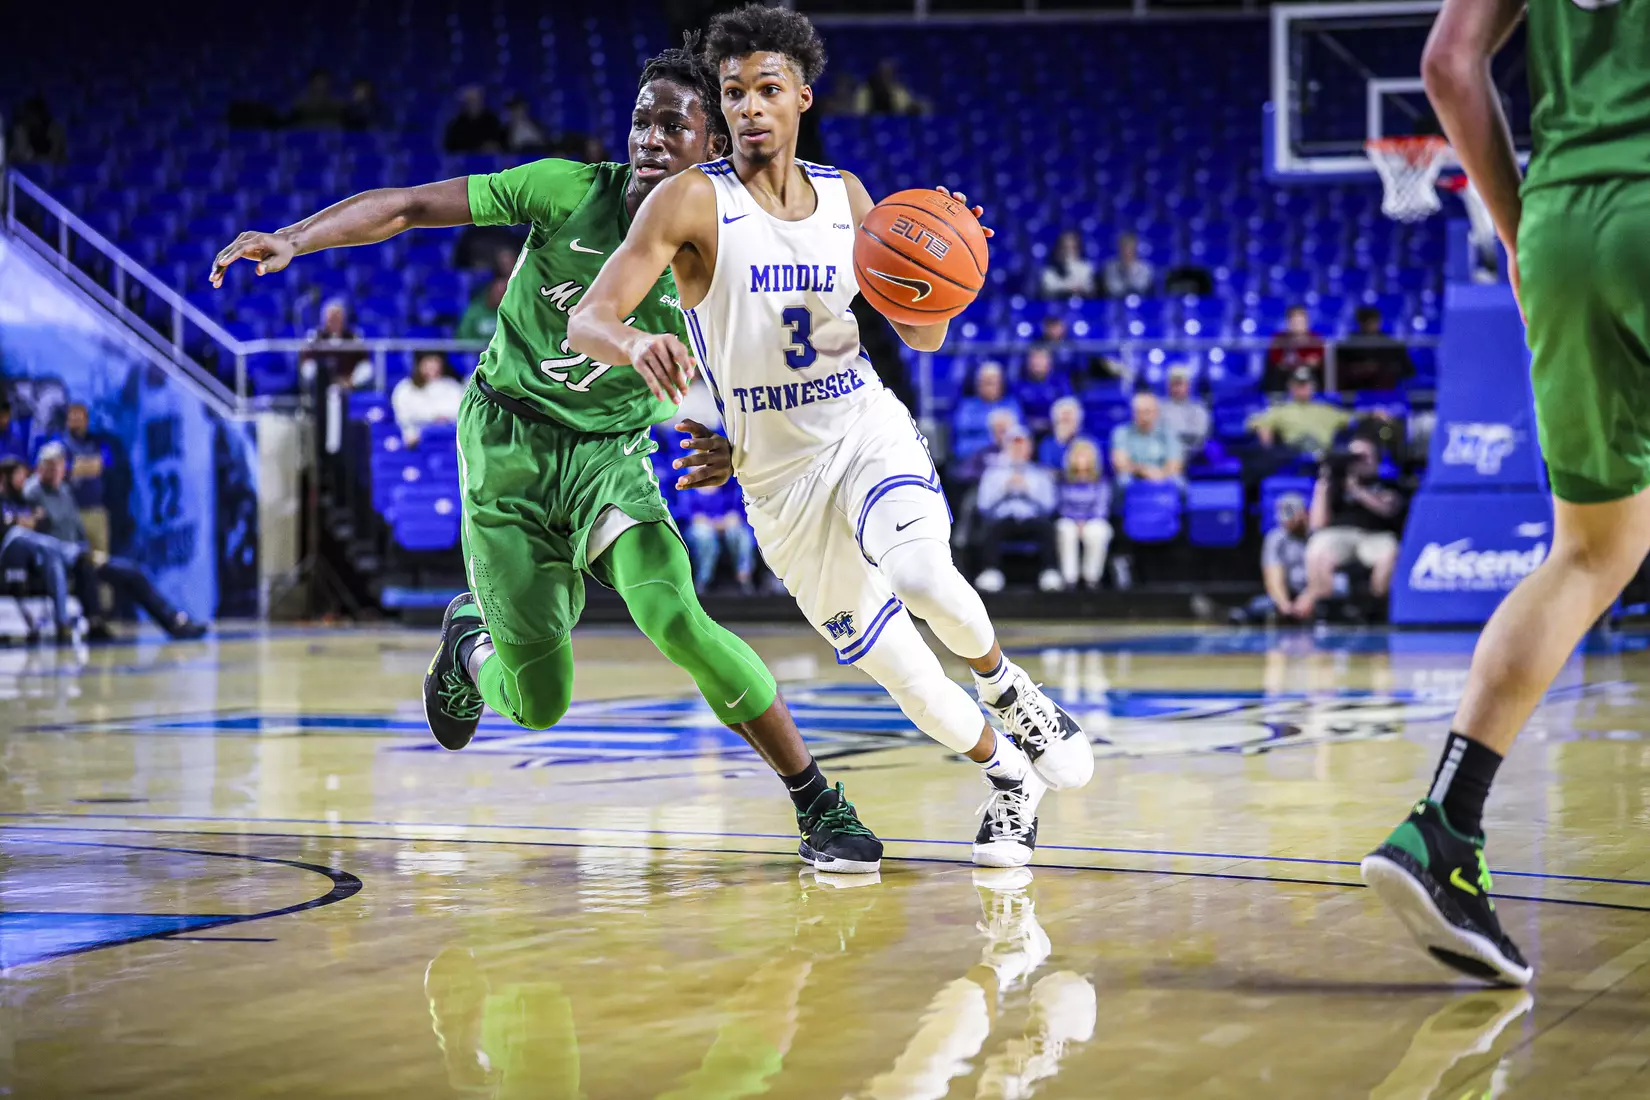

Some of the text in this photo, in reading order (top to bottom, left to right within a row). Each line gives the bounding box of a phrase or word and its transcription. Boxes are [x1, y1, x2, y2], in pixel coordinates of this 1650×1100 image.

[890, 217, 950, 261] ELITE
[750, 265, 836, 292] MIDDLE
[781, 304, 819, 371] 3
[540, 338, 613, 392] 21
[733, 368, 865, 413] TENNESSEE
[1409, 540, 1548, 580] Ascend
[825, 614, 857, 640] MT
